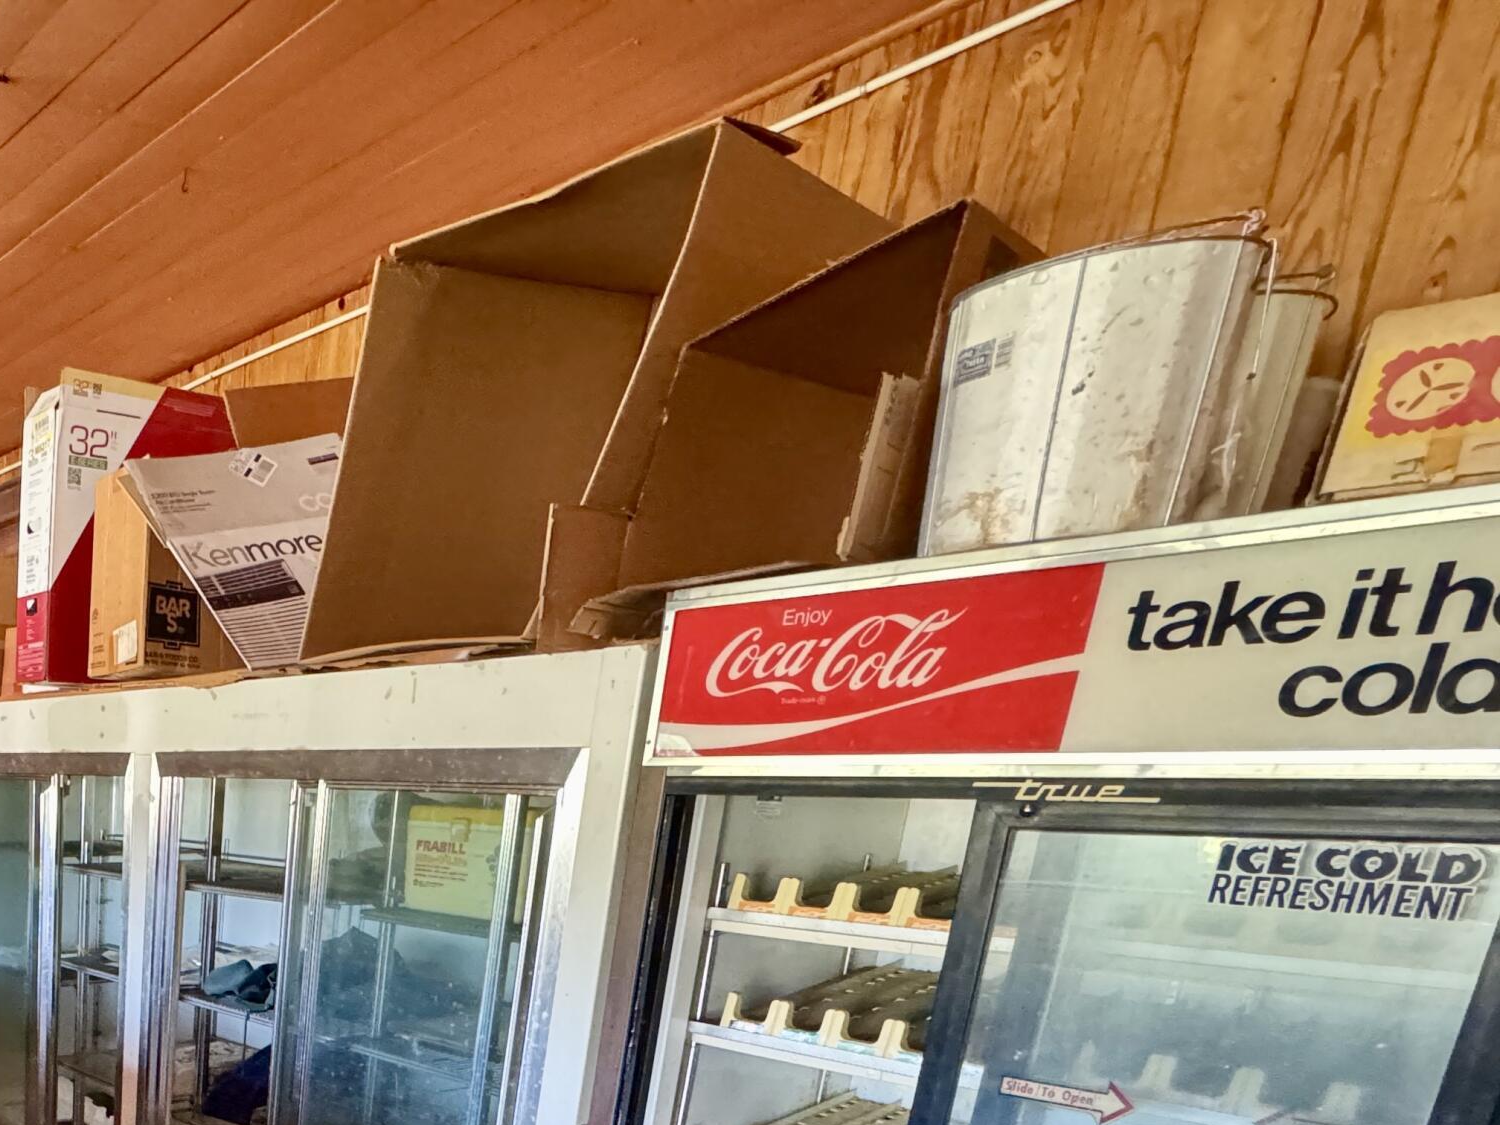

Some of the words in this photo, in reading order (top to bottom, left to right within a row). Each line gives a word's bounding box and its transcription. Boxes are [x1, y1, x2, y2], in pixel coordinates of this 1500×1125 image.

[181, 534, 323, 569] Kenmore
[156, 595, 191, 618] BAR
[782, 607, 832, 627] Enjoy
[1127, 580, 1326, 651] take
[1337, 567, 1413, 639] it
[1415, 560, 1500, 635] h
[166, 612, 178, 633] S
[705, 606, 969, 698] Coca-Cola
[972, 779, 1161, 803] true
[416, 839, 466, 855] FRABILL
[1216, 843, 1303, 875] ICE
[1315, 846, 1483, 884] COLD
[1208, 874, 1474, 921] REFRESHMENT
[1005, 1080, 1034, 1094] Slide
[1041, 1086, 1056, 1098] To
[1062, 1090, 1094, 1106] Open
